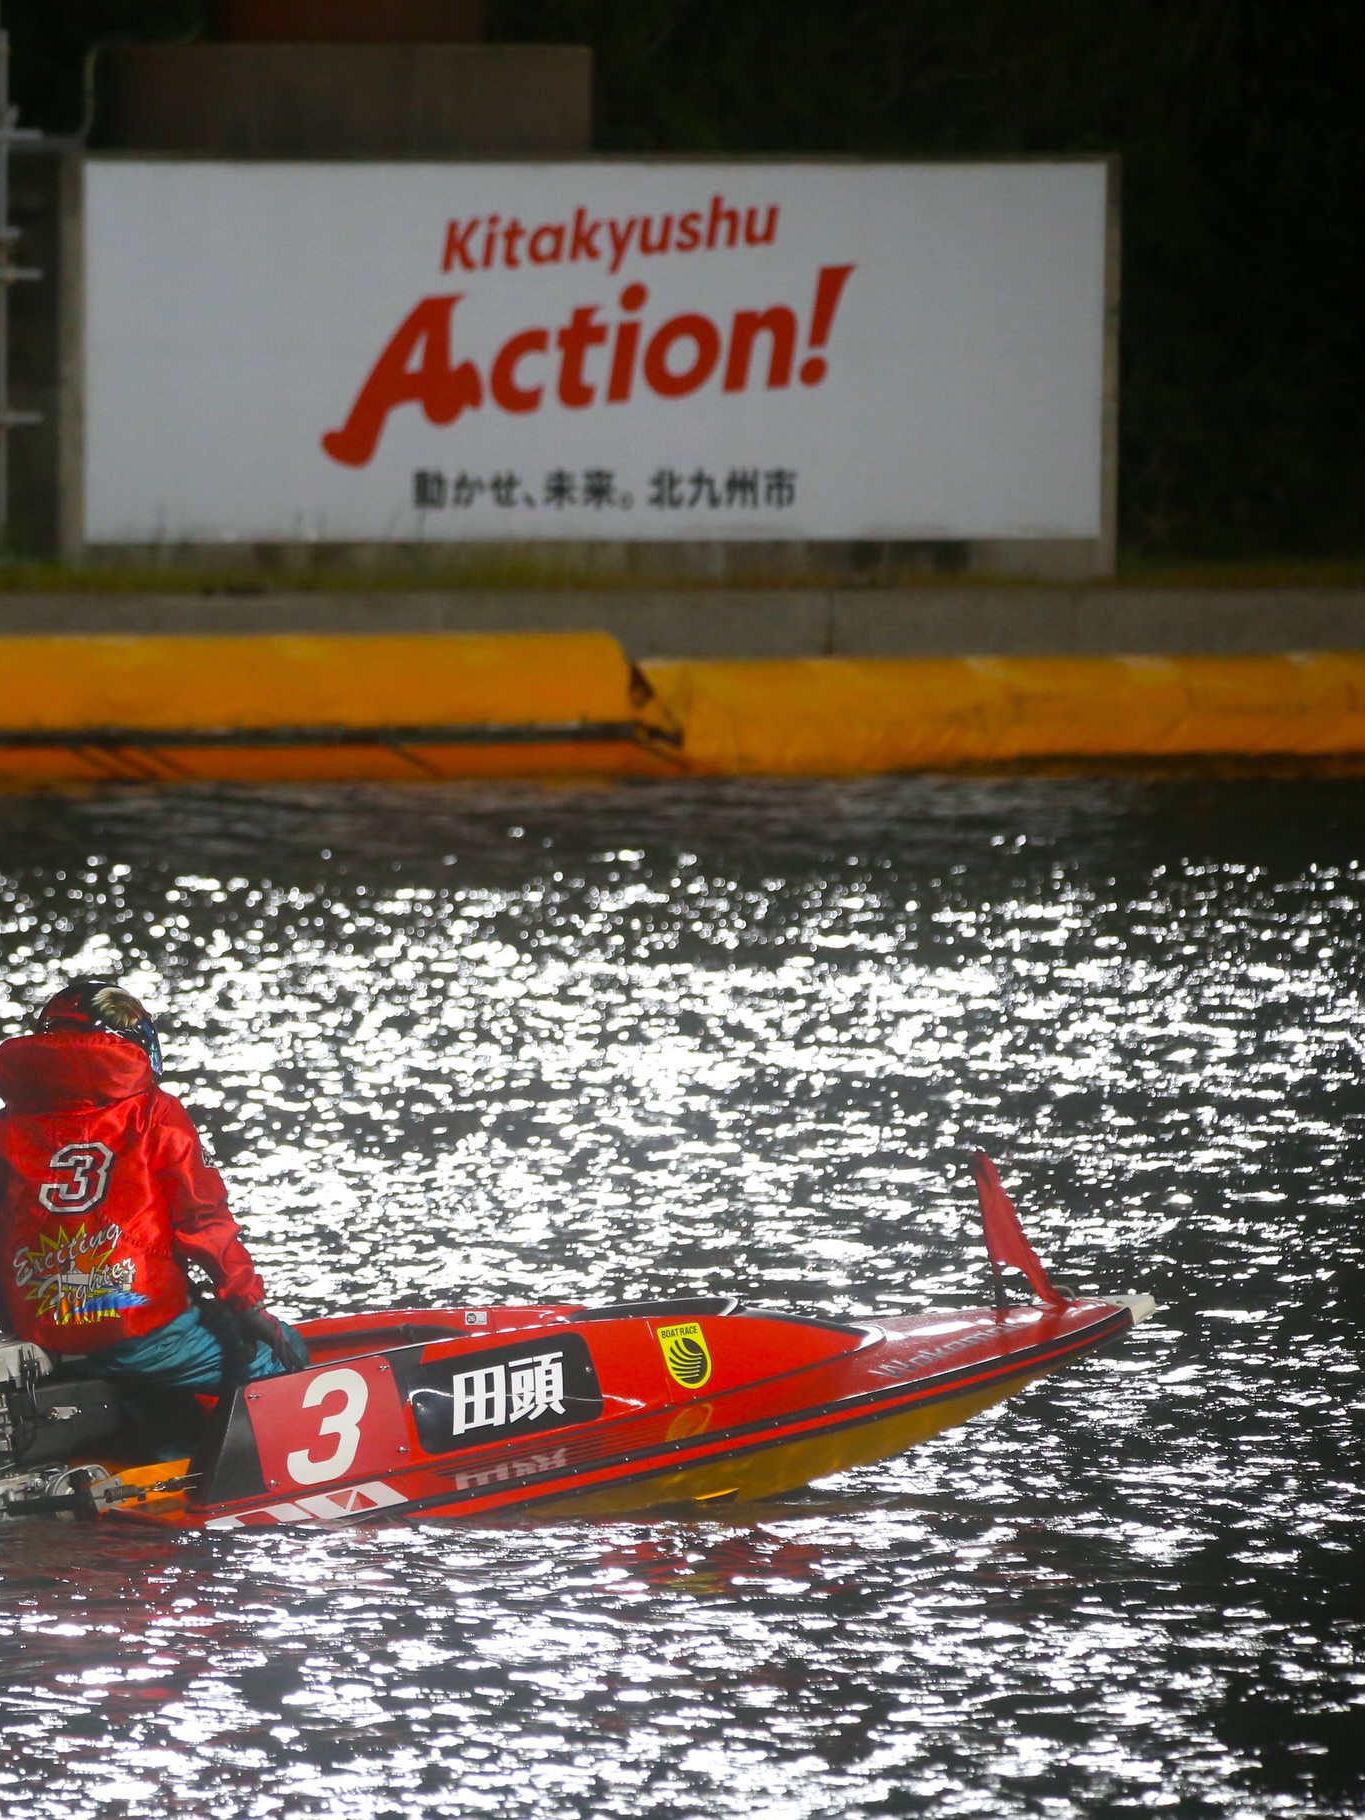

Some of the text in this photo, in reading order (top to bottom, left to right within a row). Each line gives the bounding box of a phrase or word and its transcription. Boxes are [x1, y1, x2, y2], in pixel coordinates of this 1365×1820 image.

[442, 195, 779, 275] Kitakyushu
[322, 264, 857, 468] Action!
[649, 468, 797, 510] 北九州市
[38, 1141, 116, 1214] 3
[13, 1223, 123, 1287] Exciting
[37, 1257, 135, 1321] Fighter
[661, 1325, 697, 1339] BOAT RACE
[287, 1367, 369, 1486] 3
[452, 1351, 567, 1436] 田頭
